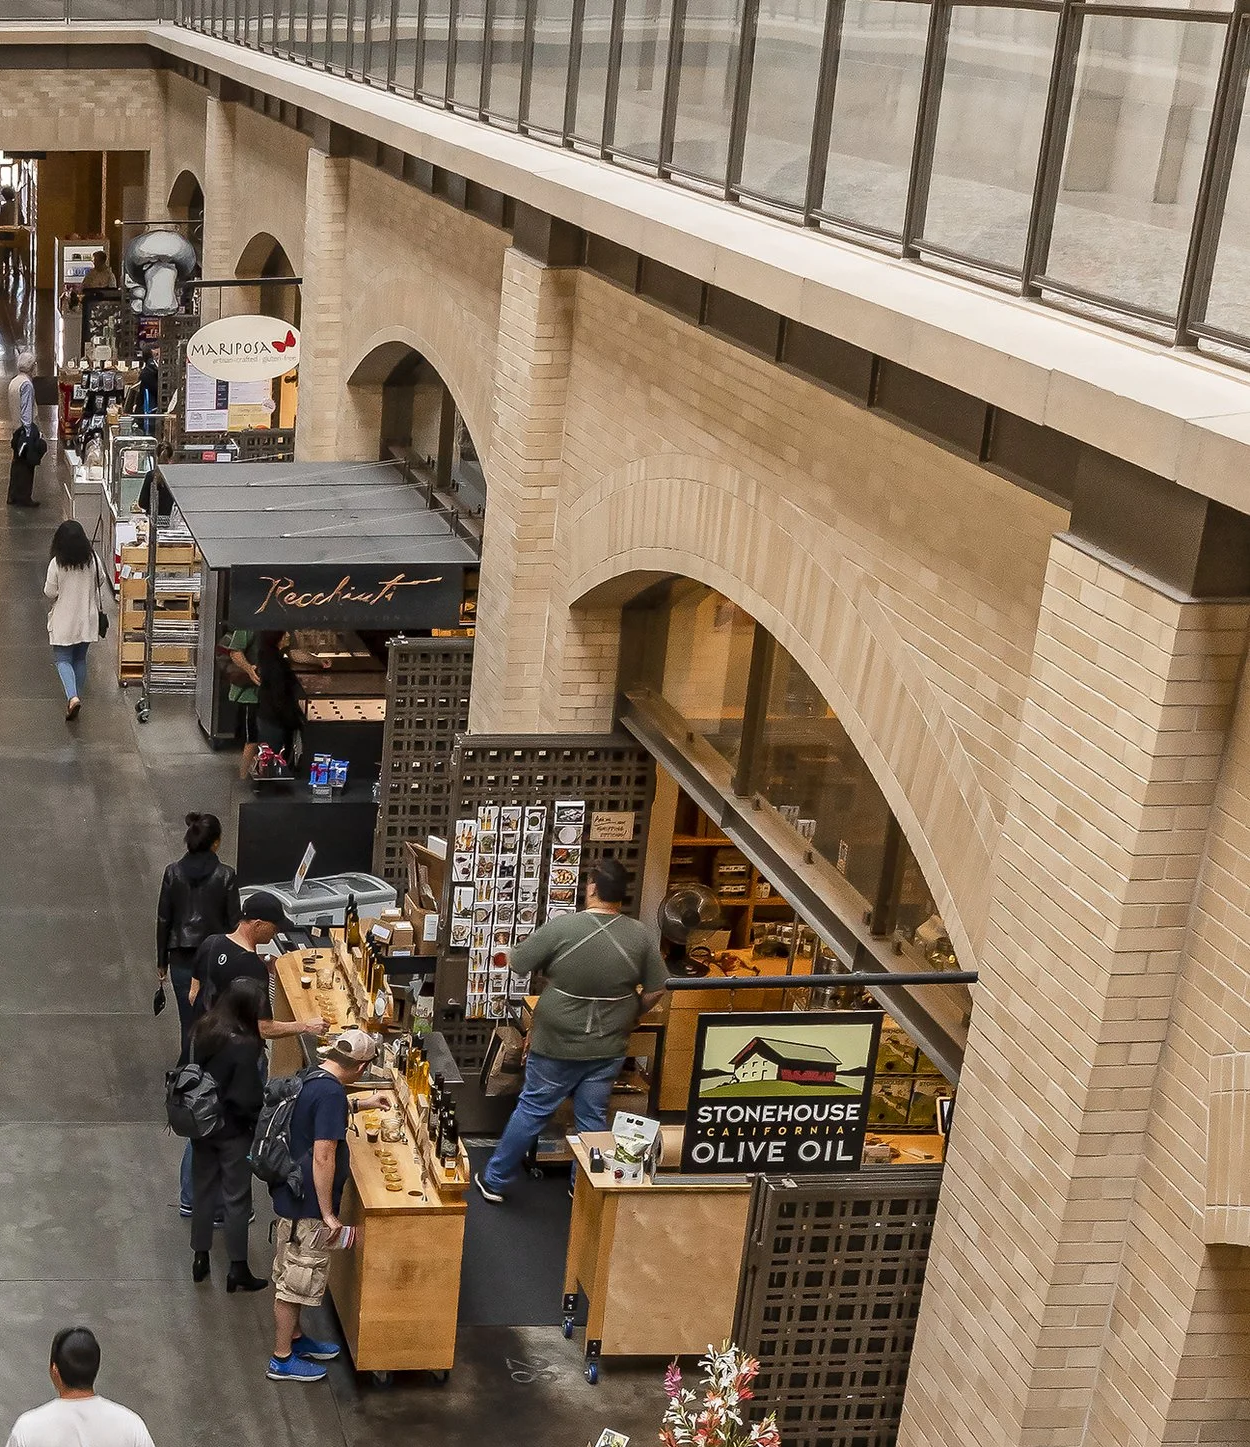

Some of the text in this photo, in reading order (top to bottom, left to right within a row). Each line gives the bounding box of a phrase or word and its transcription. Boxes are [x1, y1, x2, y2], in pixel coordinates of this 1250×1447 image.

[191, 341, 271, 356] MARIPOSA
[254, 573, 443, 615] Recchiuti
[697, 1103, 861, 1123] STONEHOUSE
[706, 1126, 845, 1137] CALIFORNIA
[691, 1140, 854, 1163] OLIVE OIL
